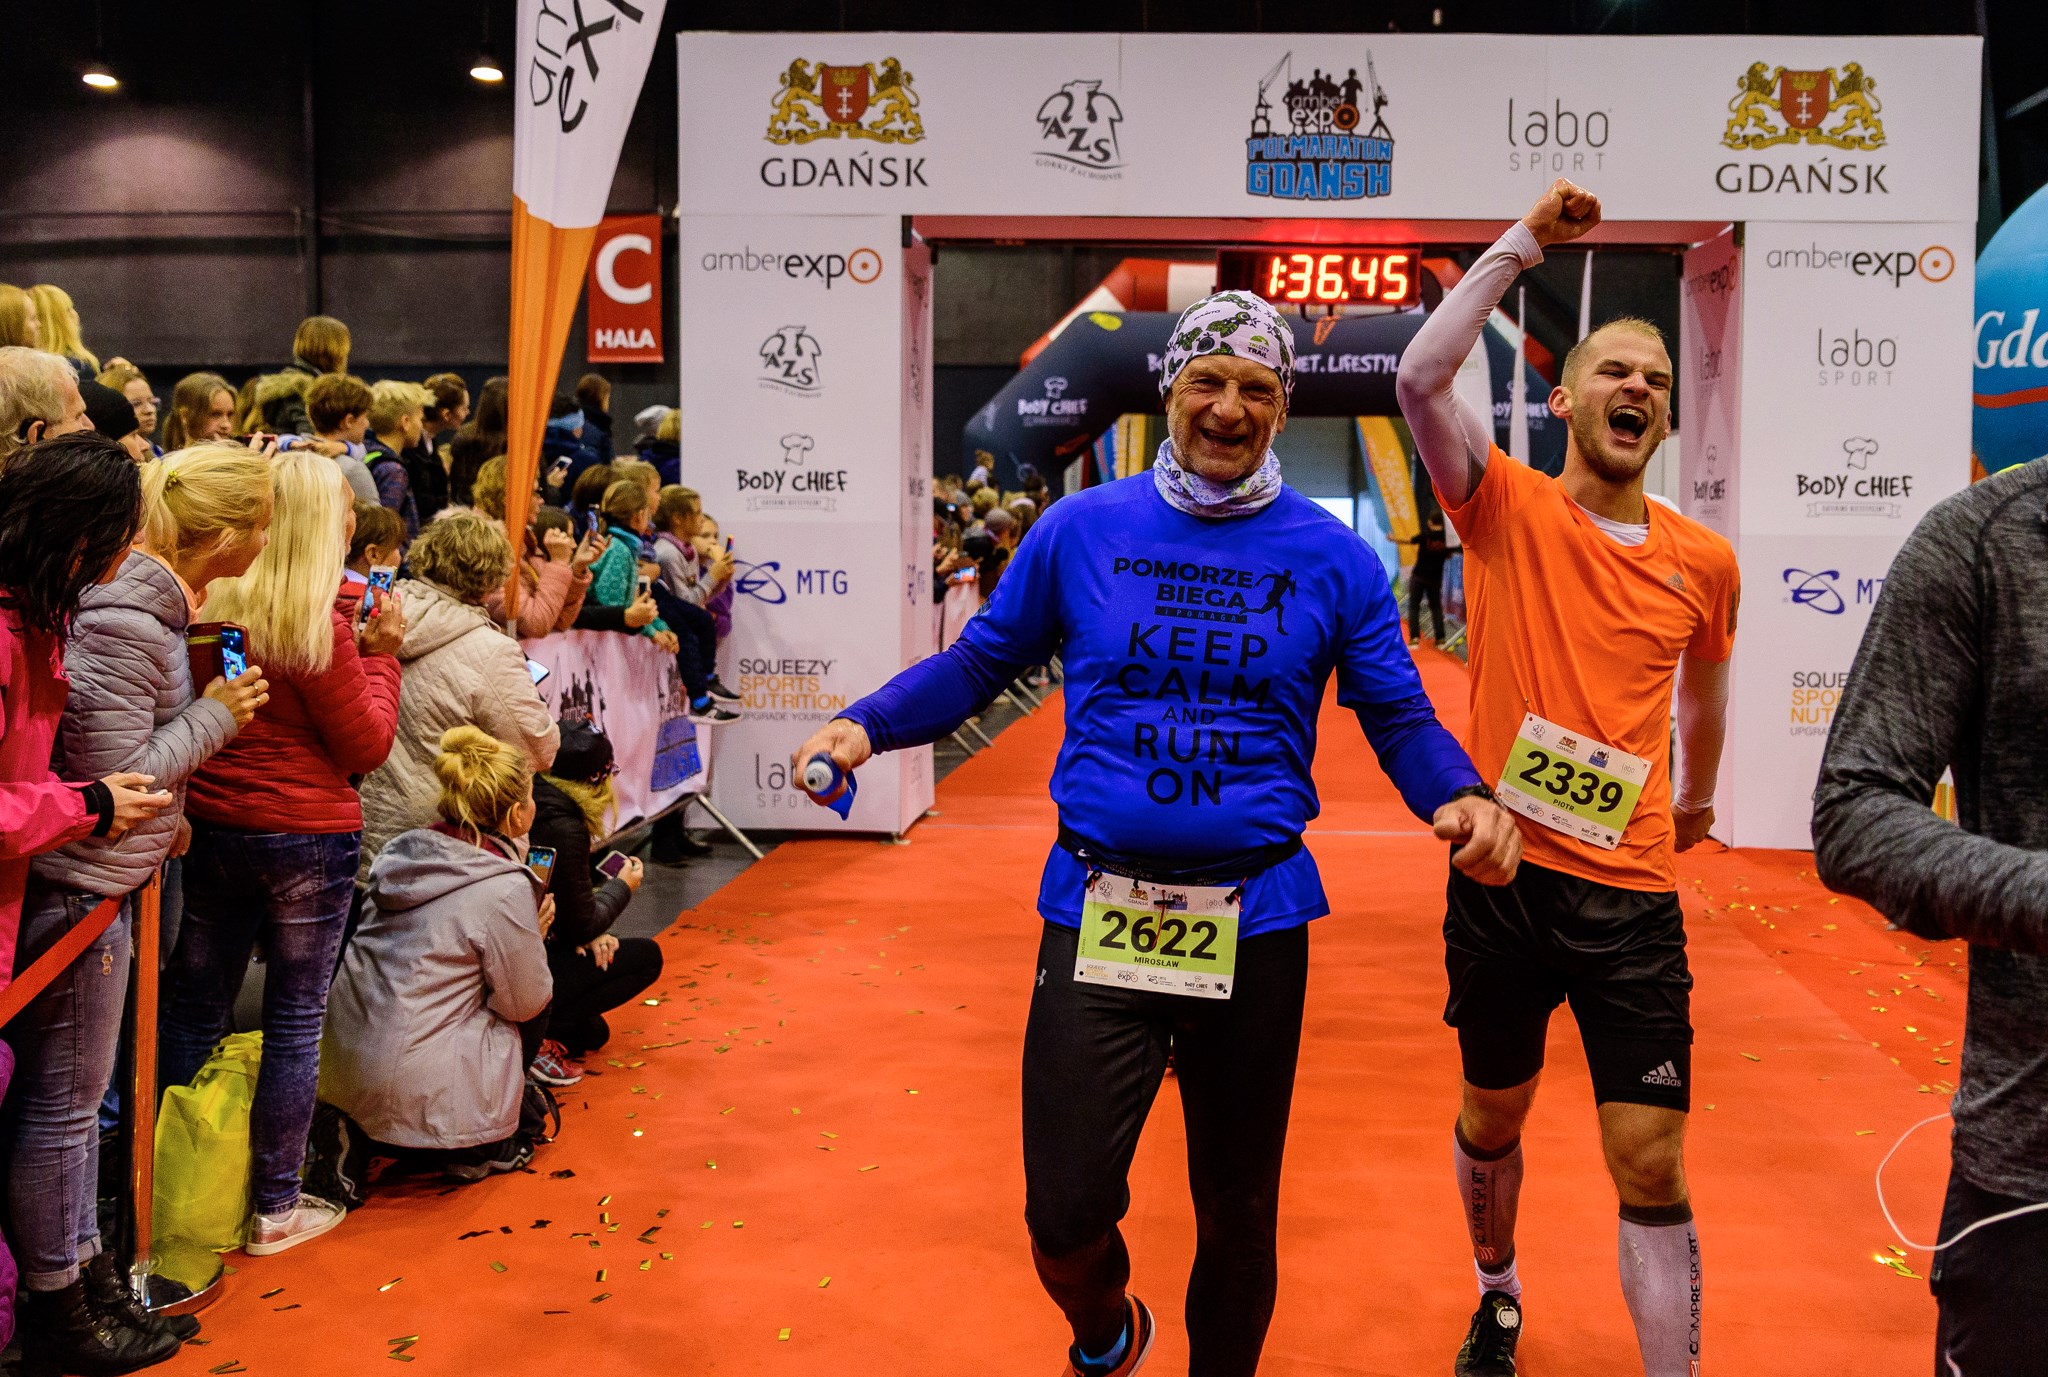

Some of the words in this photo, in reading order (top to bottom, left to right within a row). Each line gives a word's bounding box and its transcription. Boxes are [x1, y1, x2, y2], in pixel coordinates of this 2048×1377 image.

[559, 0, 645, 133] ex
[1508, 98, 1610, 148] labo
[1043, 116, 1111, 162] AZS
[760, 151, 929, 188] GDAŃSK
[1509, 153, 1606, 172] SPORT
[1715, 157, 1890, 194] GDAŃSK
[595, 234, 653, 304] C
[595, 328, 657, 349] HALA
[1818, 328, 1897, 367] labo
[764, 352, 813, 385] AZS
[1817, 371, 1893, 386] SPORT
[736, 469, 786, 494] BODY
[791, 470, 848, 492] CHIEF
[1796, 474, 1849, 499] BODY
[1854, 475, 1913, 498] CHIEF
[796, 570, 849, 596] MTG
[1113, 557, 1254, 589] POMORZE
[1156, 583, 1248, 610] BIEGA
[1176, 609, 1237, 622] POMAGA
[1127, 622, 1268, 669] KEEP
[739, 658, 832, 675] SQUEEZY
[739, 675, 820, 693] SPORTS
[1117, 663, 1272, 711] CALM
[738, 693, 847, 710] NUTRITION
[1162, 705, 1217, 725] AND
[1133, 722, 1241, 764] RUN
[1146, 767, 1222, 807] ON
[1519, 750, 1624, 813] 2339
[1552, 798, 1576, 813] PIOTR
[1099, 910, 1218, 961] 2622
[1134, 956, 1180, 968] MIROSŁAW
[1642, 1072, 1682, 1087] adidas
